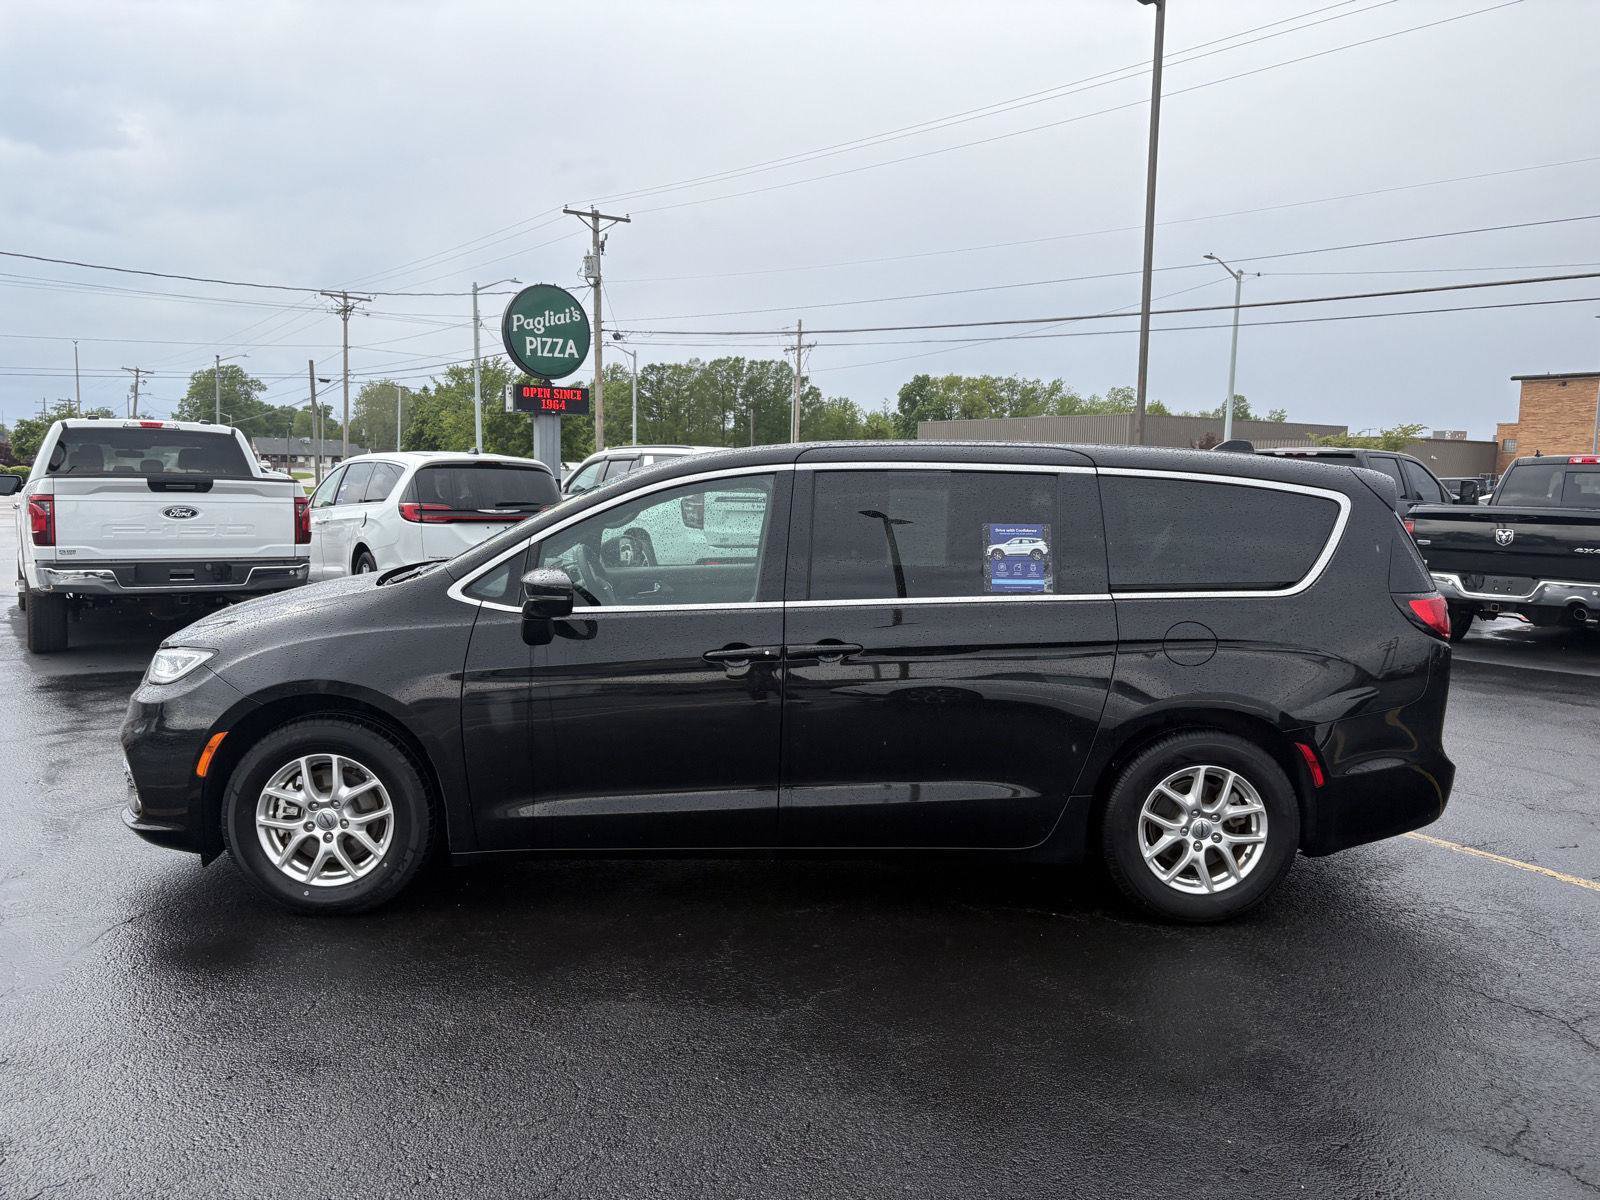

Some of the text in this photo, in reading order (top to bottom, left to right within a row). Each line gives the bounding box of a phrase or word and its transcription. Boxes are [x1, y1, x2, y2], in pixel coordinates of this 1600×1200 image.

[512, 307, 581, 334] Pagliai's
[525, 337, 579, 358] PIZZA
[522, 387, 582, 400] OPEN SINCE
[541, 399, 566, 410] 1964
[168, 508, 192, 518] Ford
